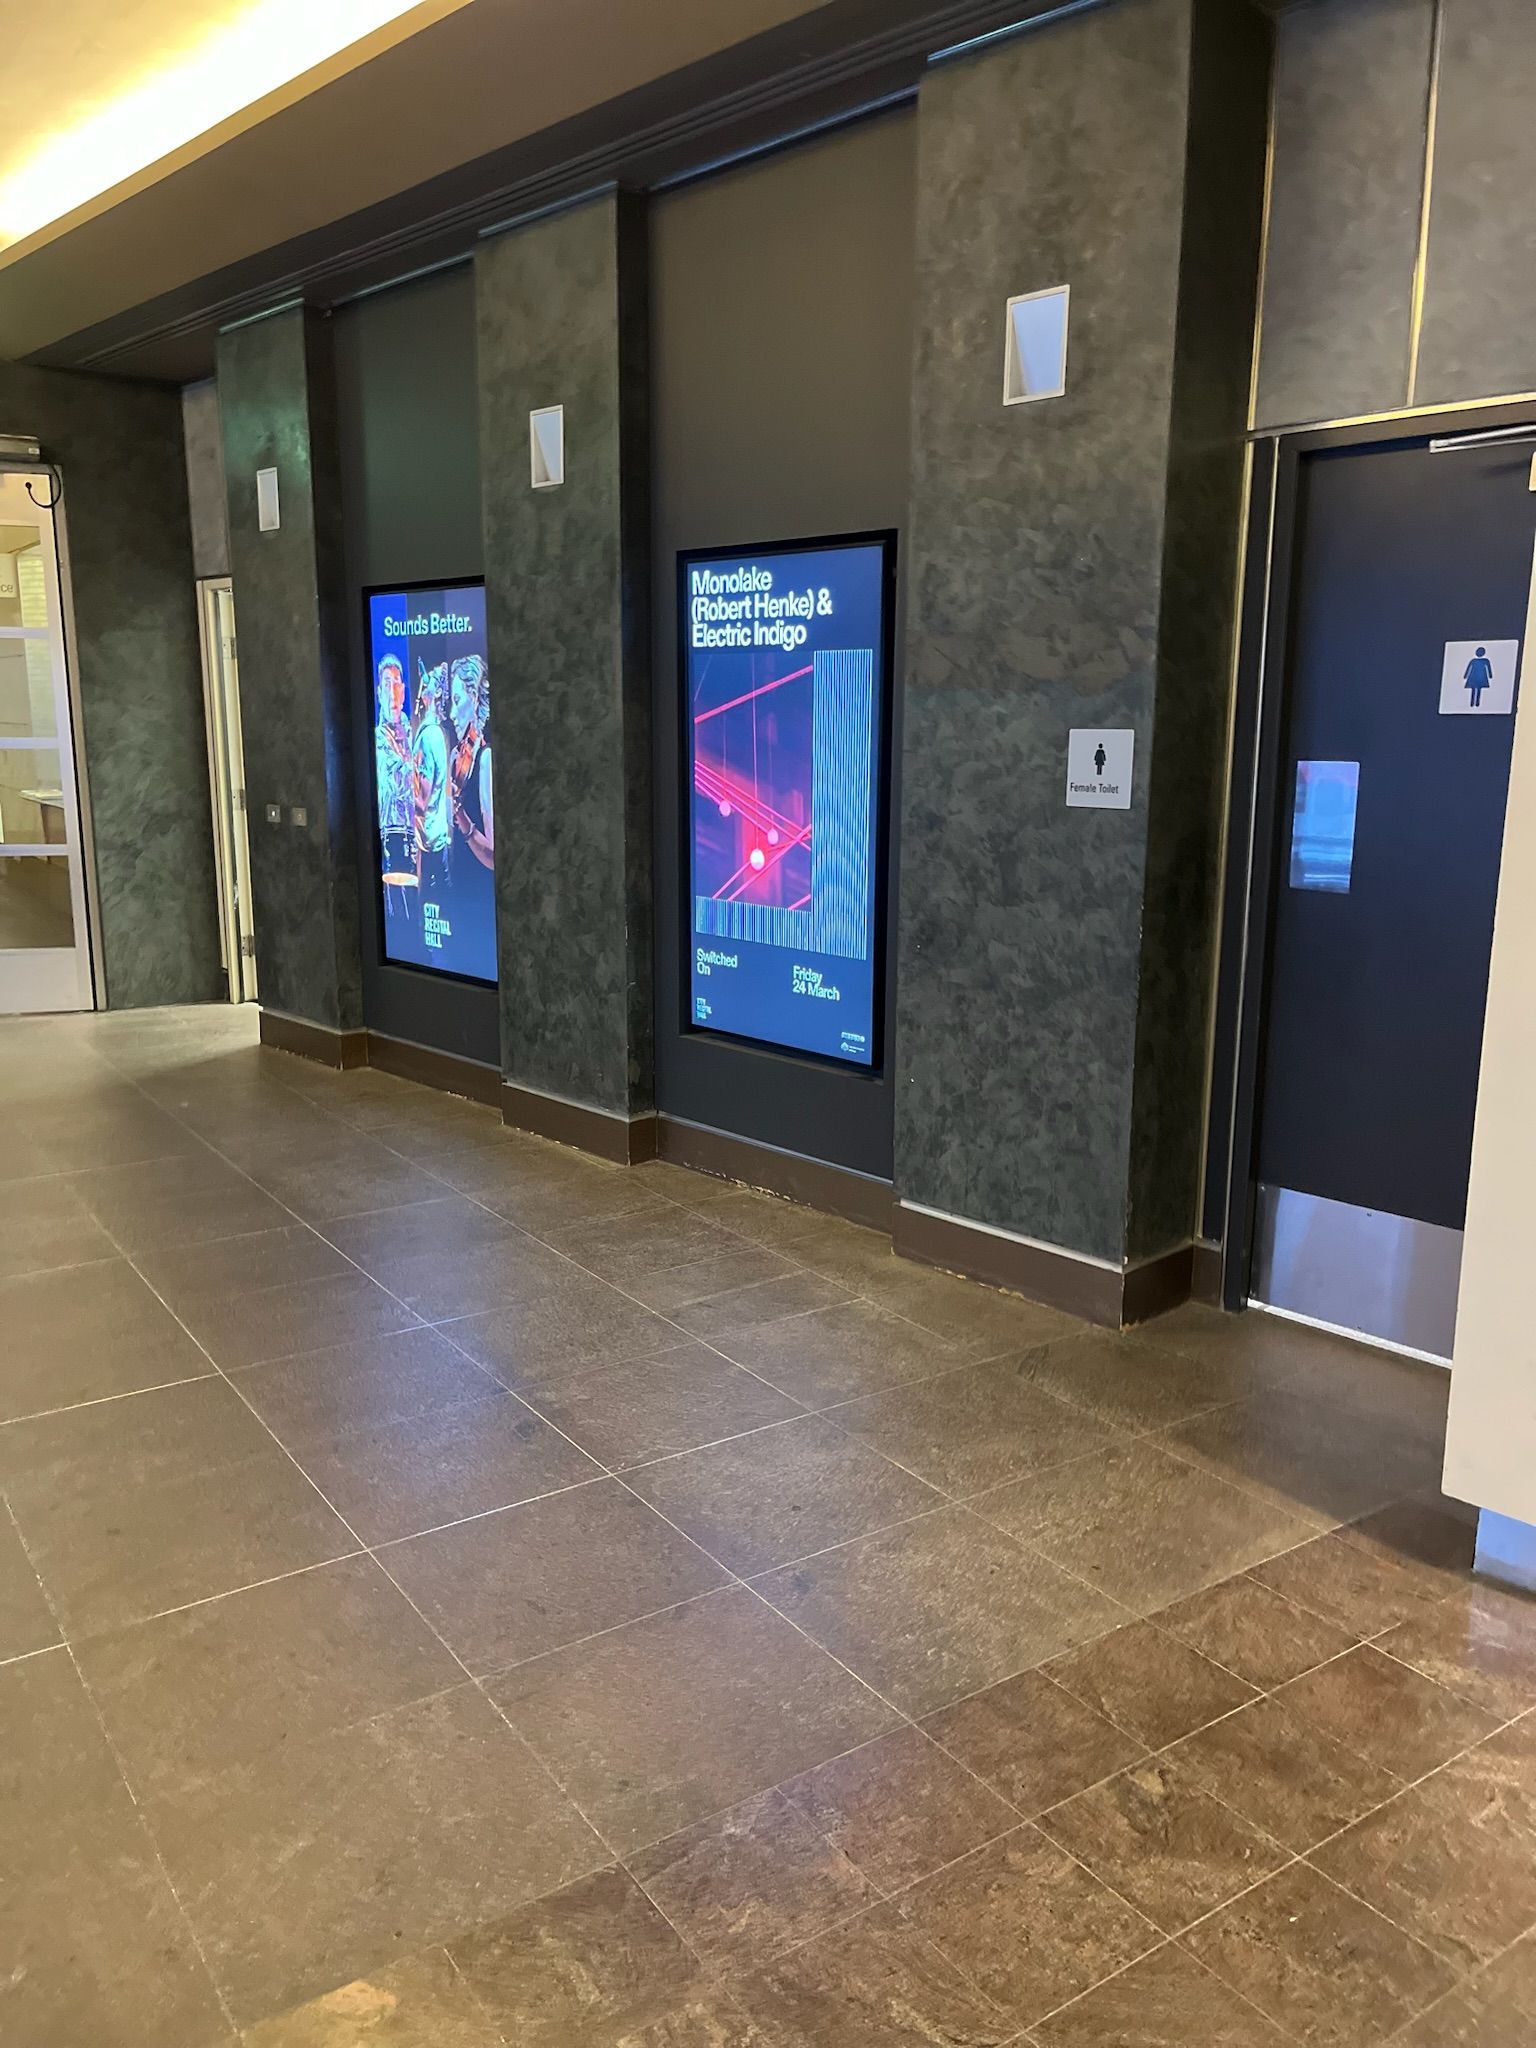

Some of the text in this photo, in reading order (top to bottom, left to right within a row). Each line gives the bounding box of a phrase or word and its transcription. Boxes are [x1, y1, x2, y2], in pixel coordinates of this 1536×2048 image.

[692, 565, 773, 595] Monolake
[691, 587, 833, 625] (Robert Henke) &
[384, 613, 473, 637] Sounds Better.
[692, 619, 807, 652] Electric Indigo
[1070, 782, 1119, 794] Female Toilet
[696, 947, 738, 969] Switched
[696, 961, 711, 976] On
[793, 964, 823, 986] Friday
[792, 979, 841, 1001] 24 March
